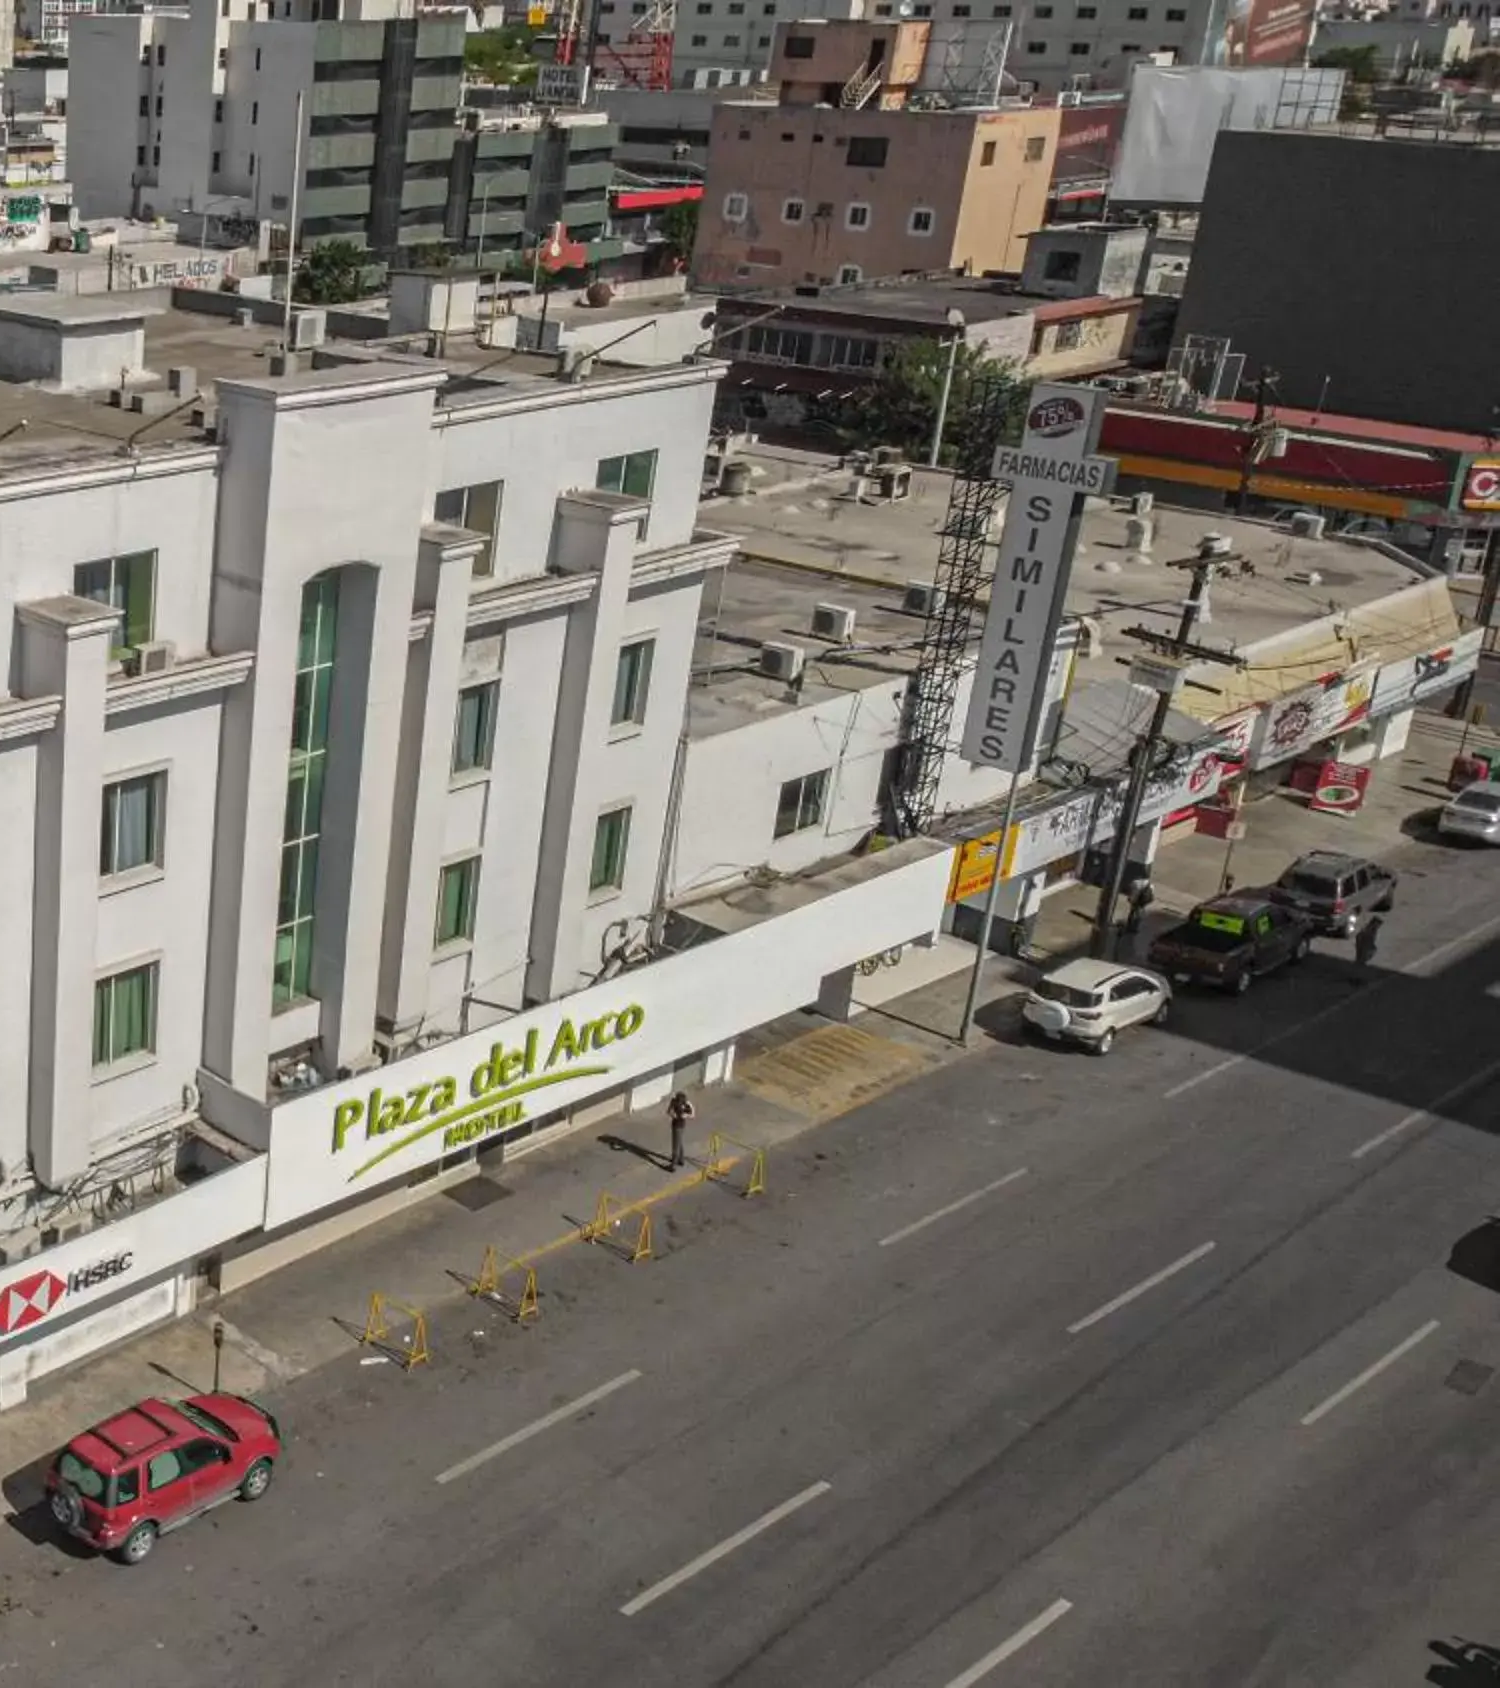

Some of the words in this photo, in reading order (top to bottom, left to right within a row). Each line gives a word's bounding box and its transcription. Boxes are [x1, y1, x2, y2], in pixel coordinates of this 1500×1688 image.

[542, 68, 579, 83] HOTEL
[153, 260, 217, 280] HELADOS
[1037, 402, 1075, 427] 75%
[999, 451, 1100, 488] FARMACIAS
[979, 495, 1053, 761] SIMILARES
[334, 1075, 457, 1151] Plaza
[472, 1027, 539, 1095] del
[545, 1003, 645, 1070] Arco
[73, 1252, 133, 1293] HSBC
